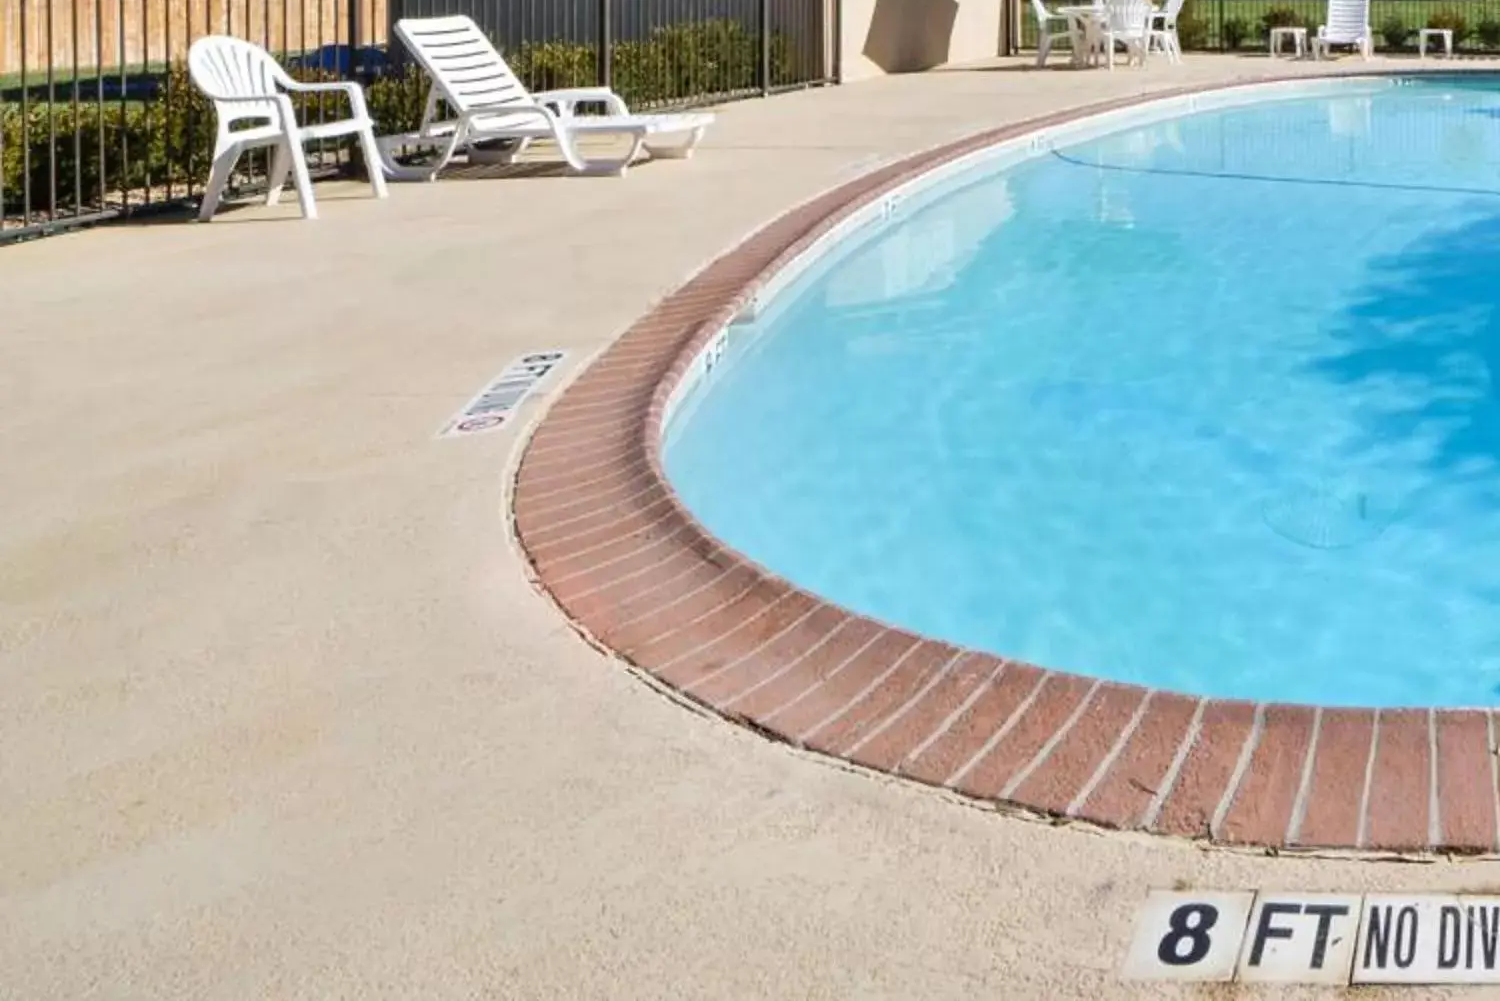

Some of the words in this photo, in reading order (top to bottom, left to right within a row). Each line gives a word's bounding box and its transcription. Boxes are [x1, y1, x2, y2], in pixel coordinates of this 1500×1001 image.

[1158, 903, 1219, 966] 8
[1248, 903, 1349, 969] FT
[1363, 905, 1418, 969] NO
